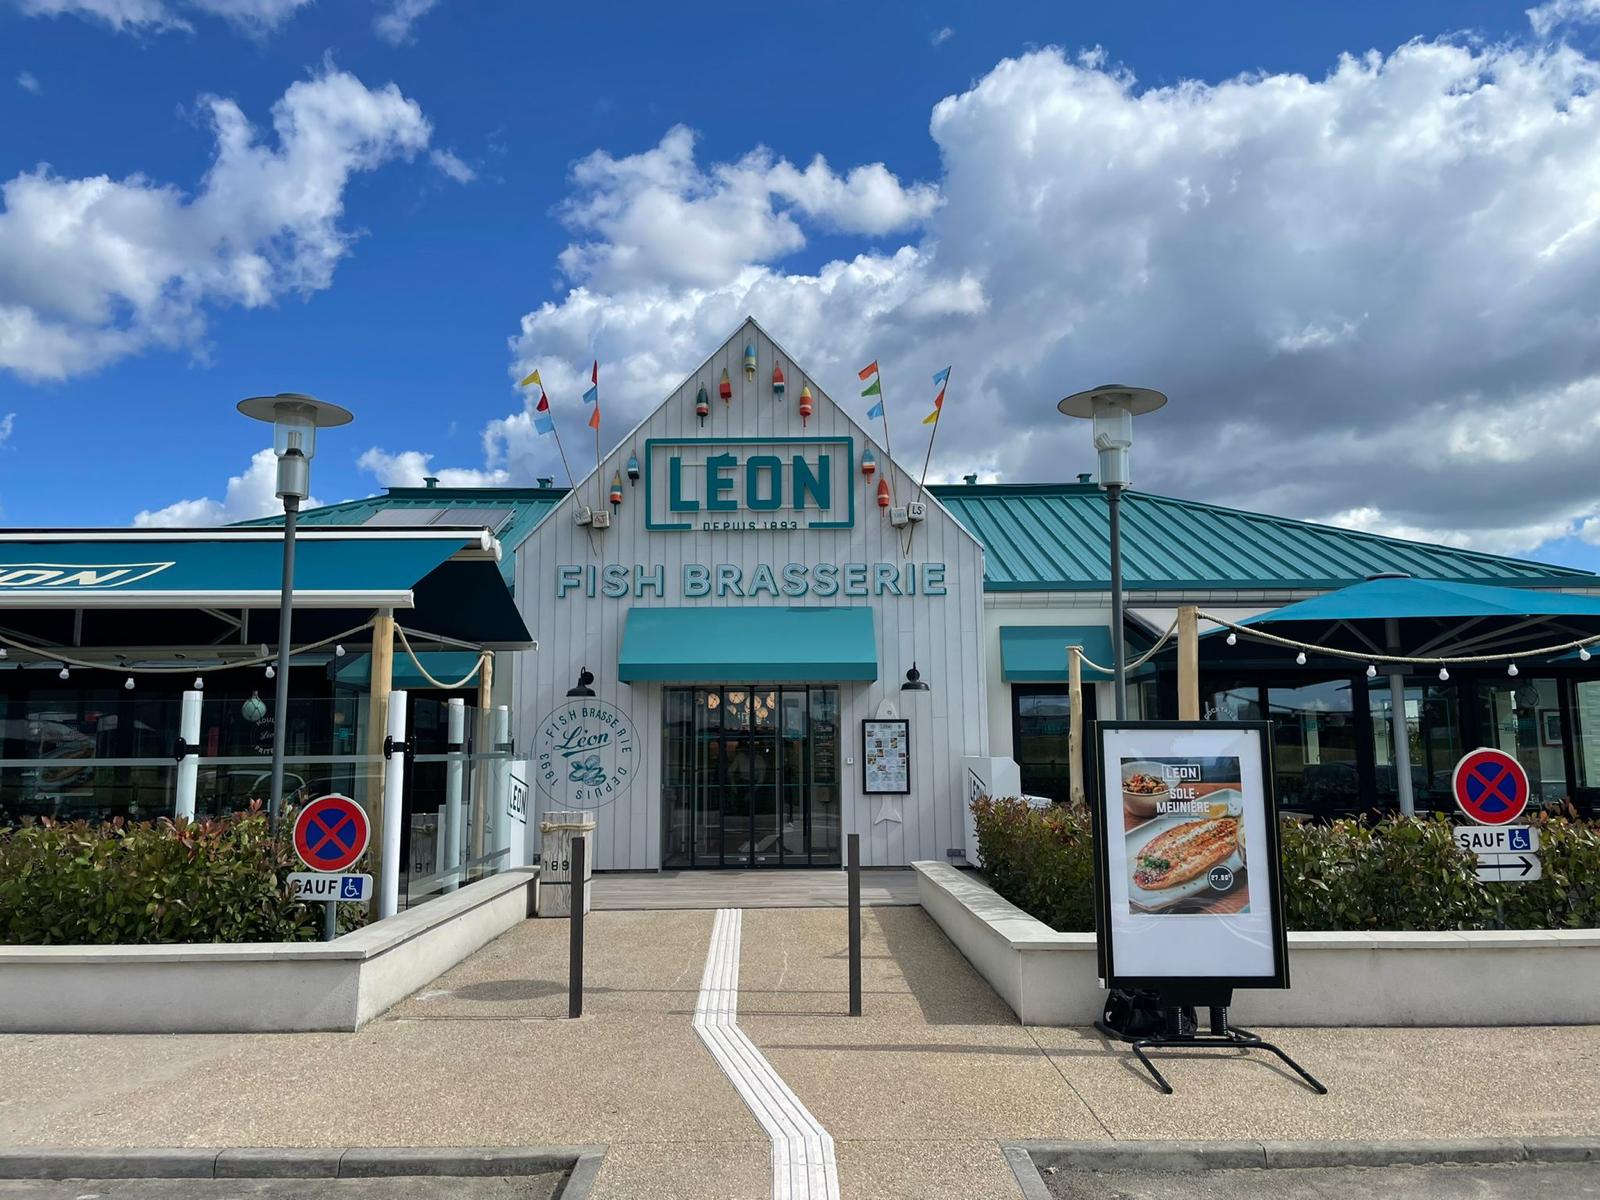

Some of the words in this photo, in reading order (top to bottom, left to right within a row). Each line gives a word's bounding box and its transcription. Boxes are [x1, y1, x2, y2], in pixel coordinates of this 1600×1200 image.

[670, 452, 830, 512] LÉON
[703, 521, 756, 532] DEPUIS
[763, 521, 798, 532] 1893
[557, 564, 664, 598] FISH
[683, 562, 947, 598] BRASSERIE
[546, 709, 577, 738] FISH
[582, 708, 632, 753] BRASSERIE
[540, 753, 559, 787] 1893
[576, 767, 627, 800] DEPUIS
[1170, 788, 1195, 799] SOLE
[1156, 800, 1210, 813] MEUNIÈRE
[1460, 833, 1505, 847] SAUF
[544, 860, 570, 871] 189
